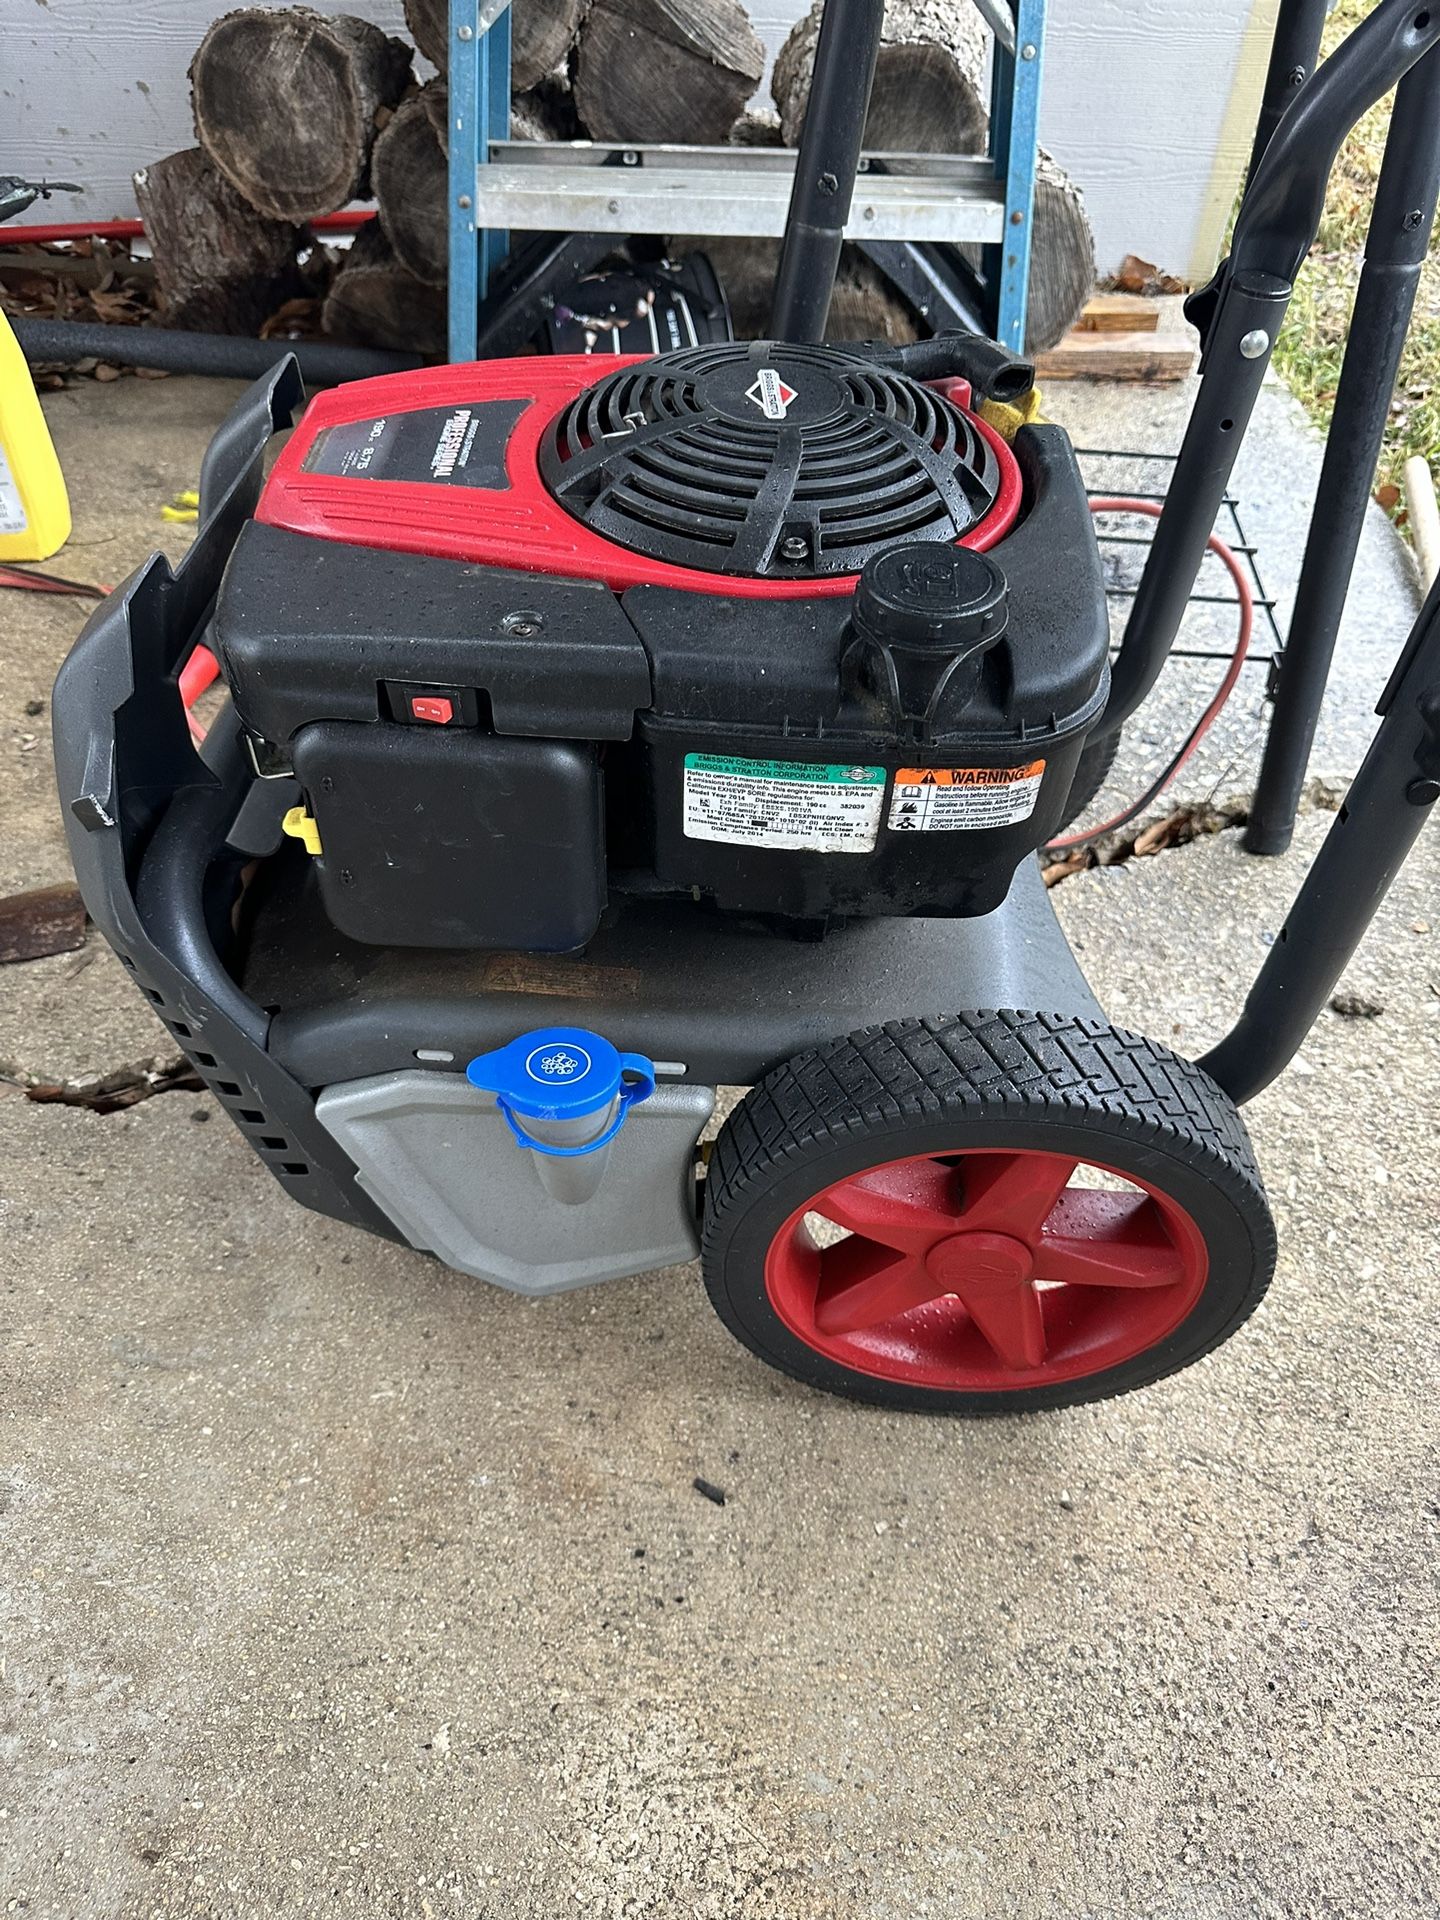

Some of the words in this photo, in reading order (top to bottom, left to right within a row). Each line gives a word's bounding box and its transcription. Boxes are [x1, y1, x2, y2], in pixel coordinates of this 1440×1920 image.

[433, 409, 472, 479] PROFESSIONAL
[697, 755, 734, 765] EMISSION
[735, 758, 772, 769] CONTROL
[773, 762, 827, 772] INFORMATION
[693, 762, 724, 771] BRIGGS
[731, 766, 772, 777] STRATTON
[773, 770, 829, 781] CORPORATION
[951, 769, 1025, 784] WARNING
[693, 777, 725, 786] emissions
[726, 780, 756, 790] durability
[773, 780, 815, 789] maintenance
[686, 781, 717, 791] California
[747, 789, 767, 797] SORE
[767, 792, 803, 800] regulations
[688, 788, 710, 796] Model
[969, 791, 988, 799] before
[988, 790, 1010, 798] running
[1009, 794, 1026, 803] engine
[688, 816, 718, 826] Emission
[930, 817, 953, 825] Engines
[971, 820, 998, 828] enclosed
